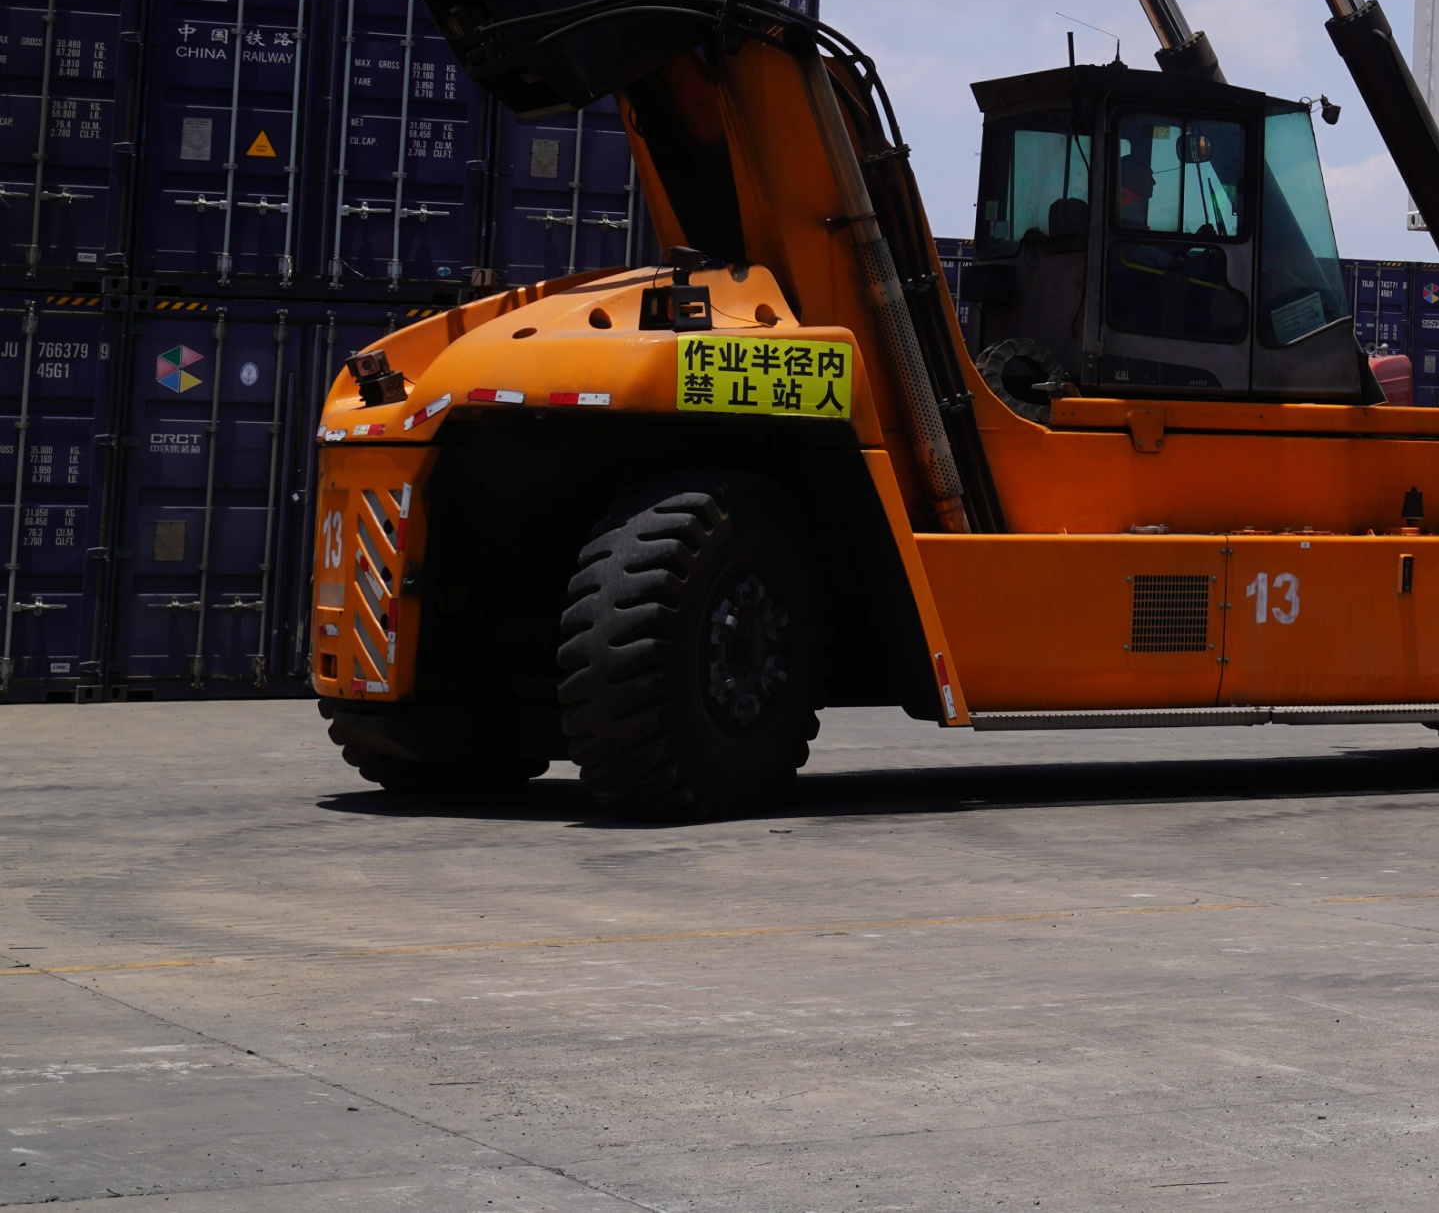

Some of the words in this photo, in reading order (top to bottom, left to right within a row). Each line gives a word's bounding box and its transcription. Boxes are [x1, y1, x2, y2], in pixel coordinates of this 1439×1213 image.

[21, 37, 43, 47] GROSS
[177, 24, 295, 47] 中国铁路
[176, 46, 227, 60] CHINA
[242, 50, 294, 64] RAILWAY
[354, 58, 371, 68] MAX
[378, 60, 400, 70] GROSS
[446, 64, 458, 73] KG.
[353, 77, 372, 87] TARE
[351, 118, 364, 127] NET
[38, 342, 88, 359] 766379
[101, 344, 109, 360] 9
[684, 340, 845, 379] 作业半径内
[36, 362, 70, 379] 45G1
[683, 373, 844, 412] 禁止站人
[150, 433, 202, 445] CRCT
[322, 510, 343, 569] 13
[1246, 572, 1301, 625] 13
